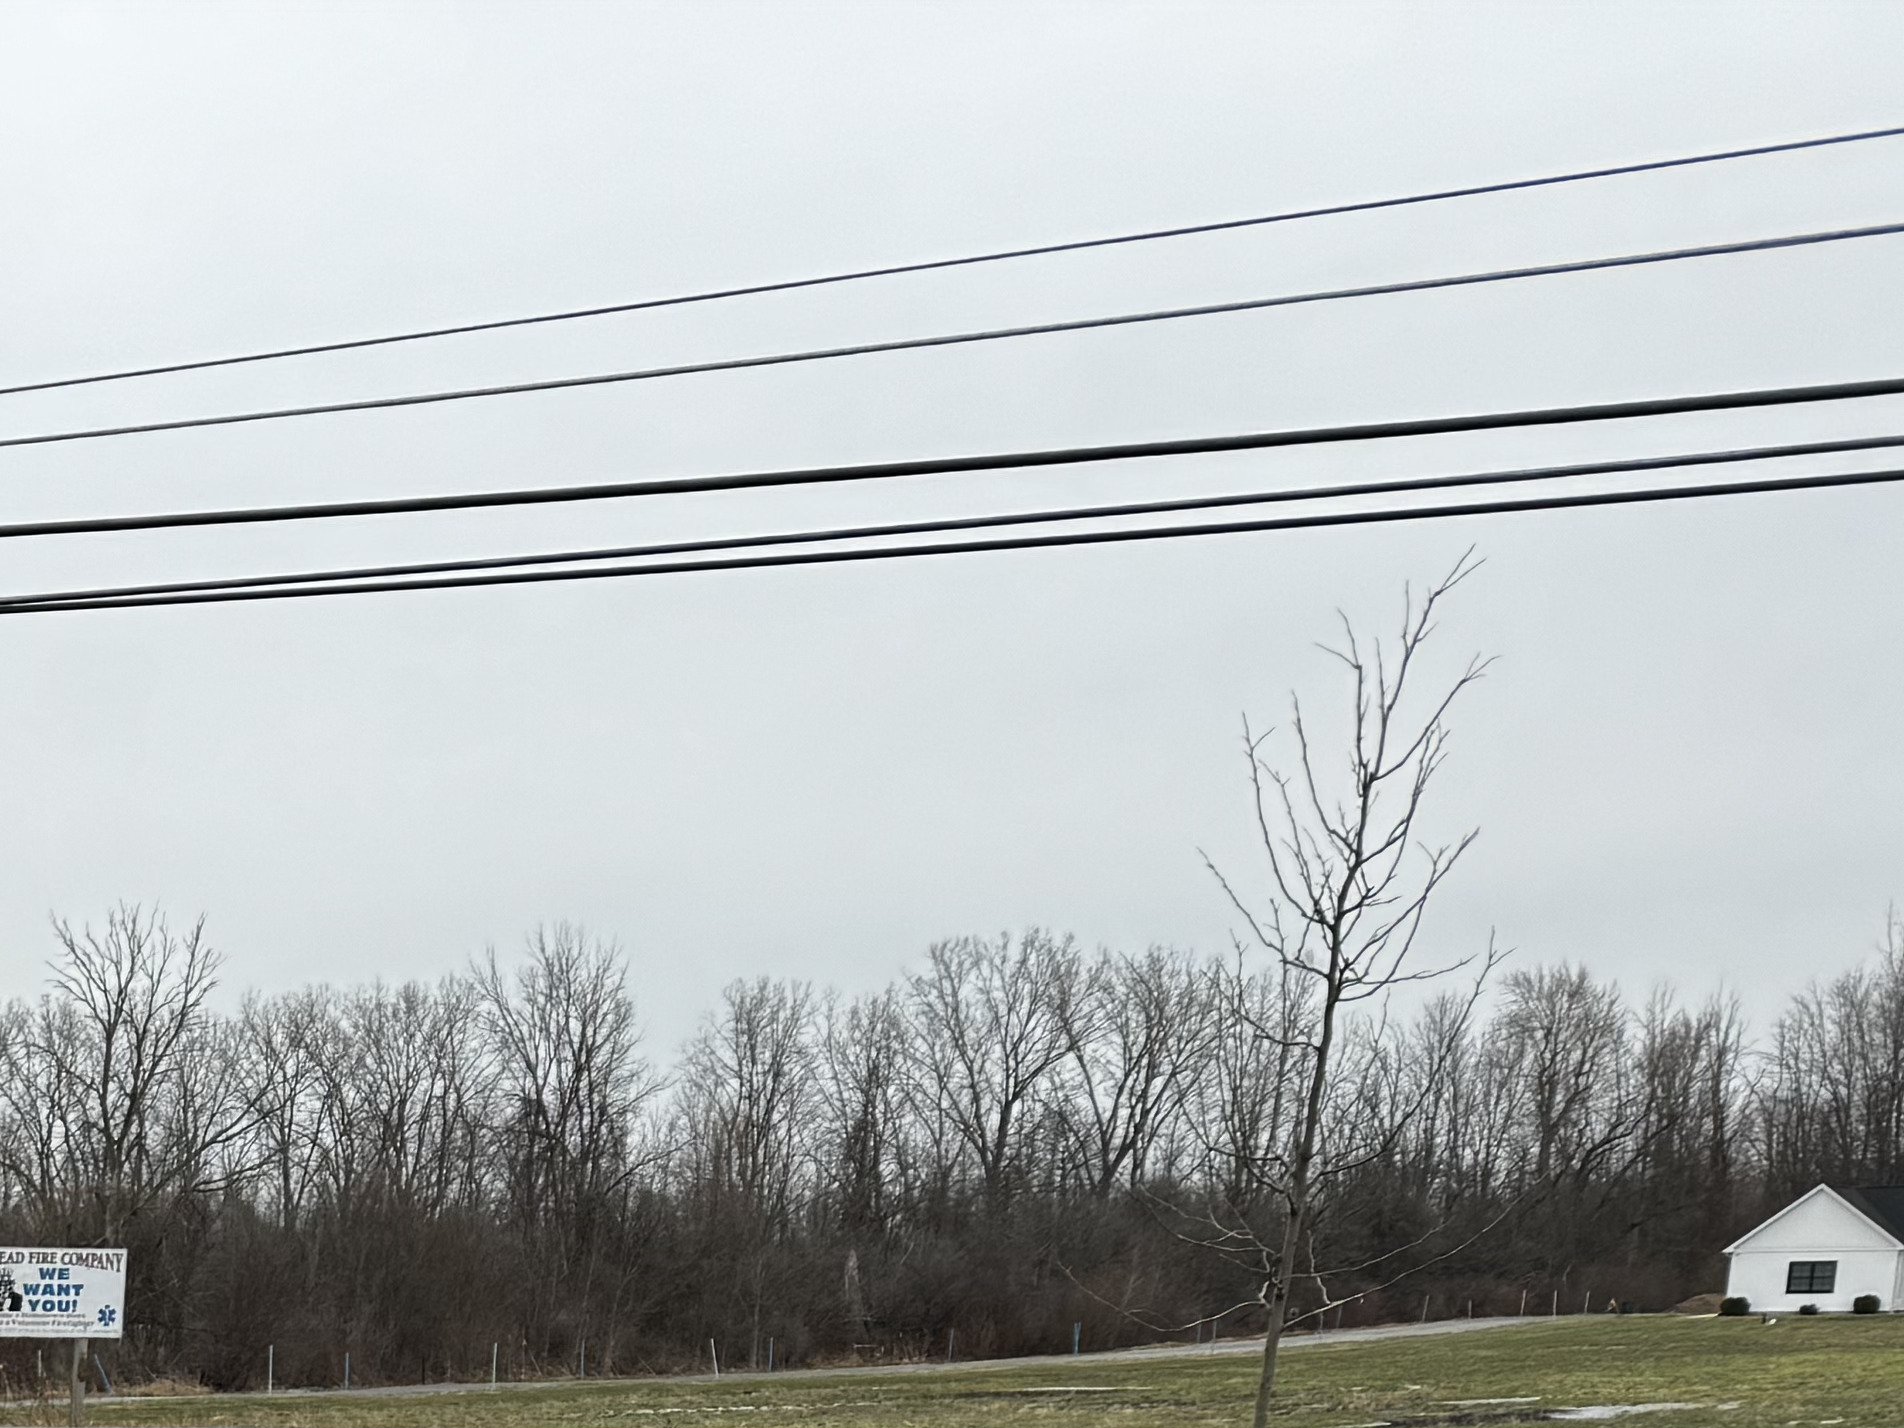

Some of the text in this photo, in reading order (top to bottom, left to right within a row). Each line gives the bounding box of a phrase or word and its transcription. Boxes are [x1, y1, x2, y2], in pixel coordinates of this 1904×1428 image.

[28, 1251, 58, 1264] FIRE
[60, 1252, 124, 1273] COMPANY
[39, 1267, 70, 1280] WE
[23, 1283, 84, 1297] WANT
[28, 1299, 78, 1312] YOU!
